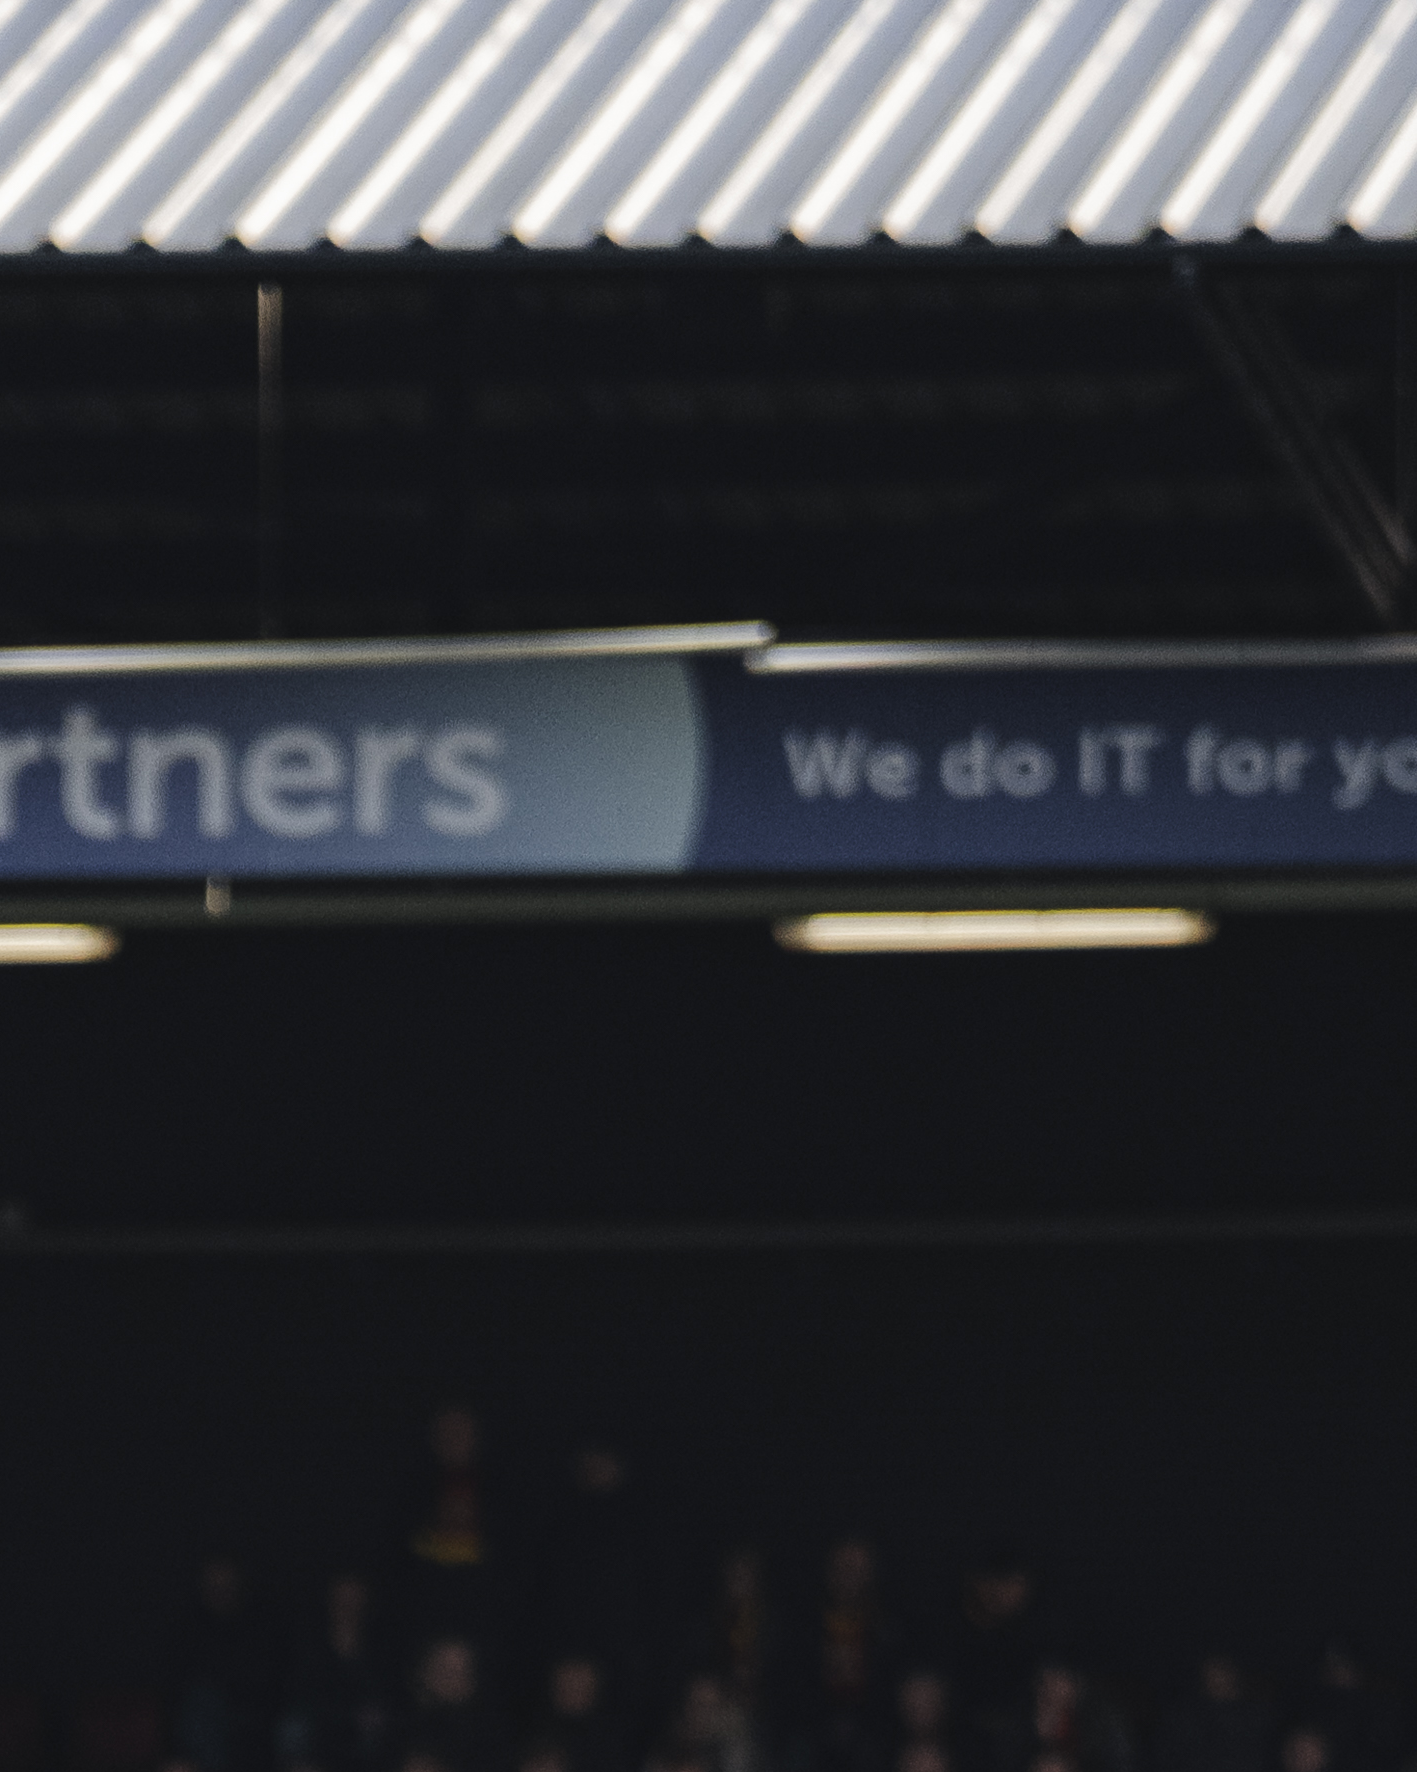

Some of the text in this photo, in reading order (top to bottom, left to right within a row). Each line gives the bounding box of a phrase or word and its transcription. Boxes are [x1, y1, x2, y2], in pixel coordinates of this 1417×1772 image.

[781, 726, 922, 801] We
[939, 726, 1057, 800] do
[1076, 724, 1161, 794] IT
[1183, 724, 1315, 796] for
